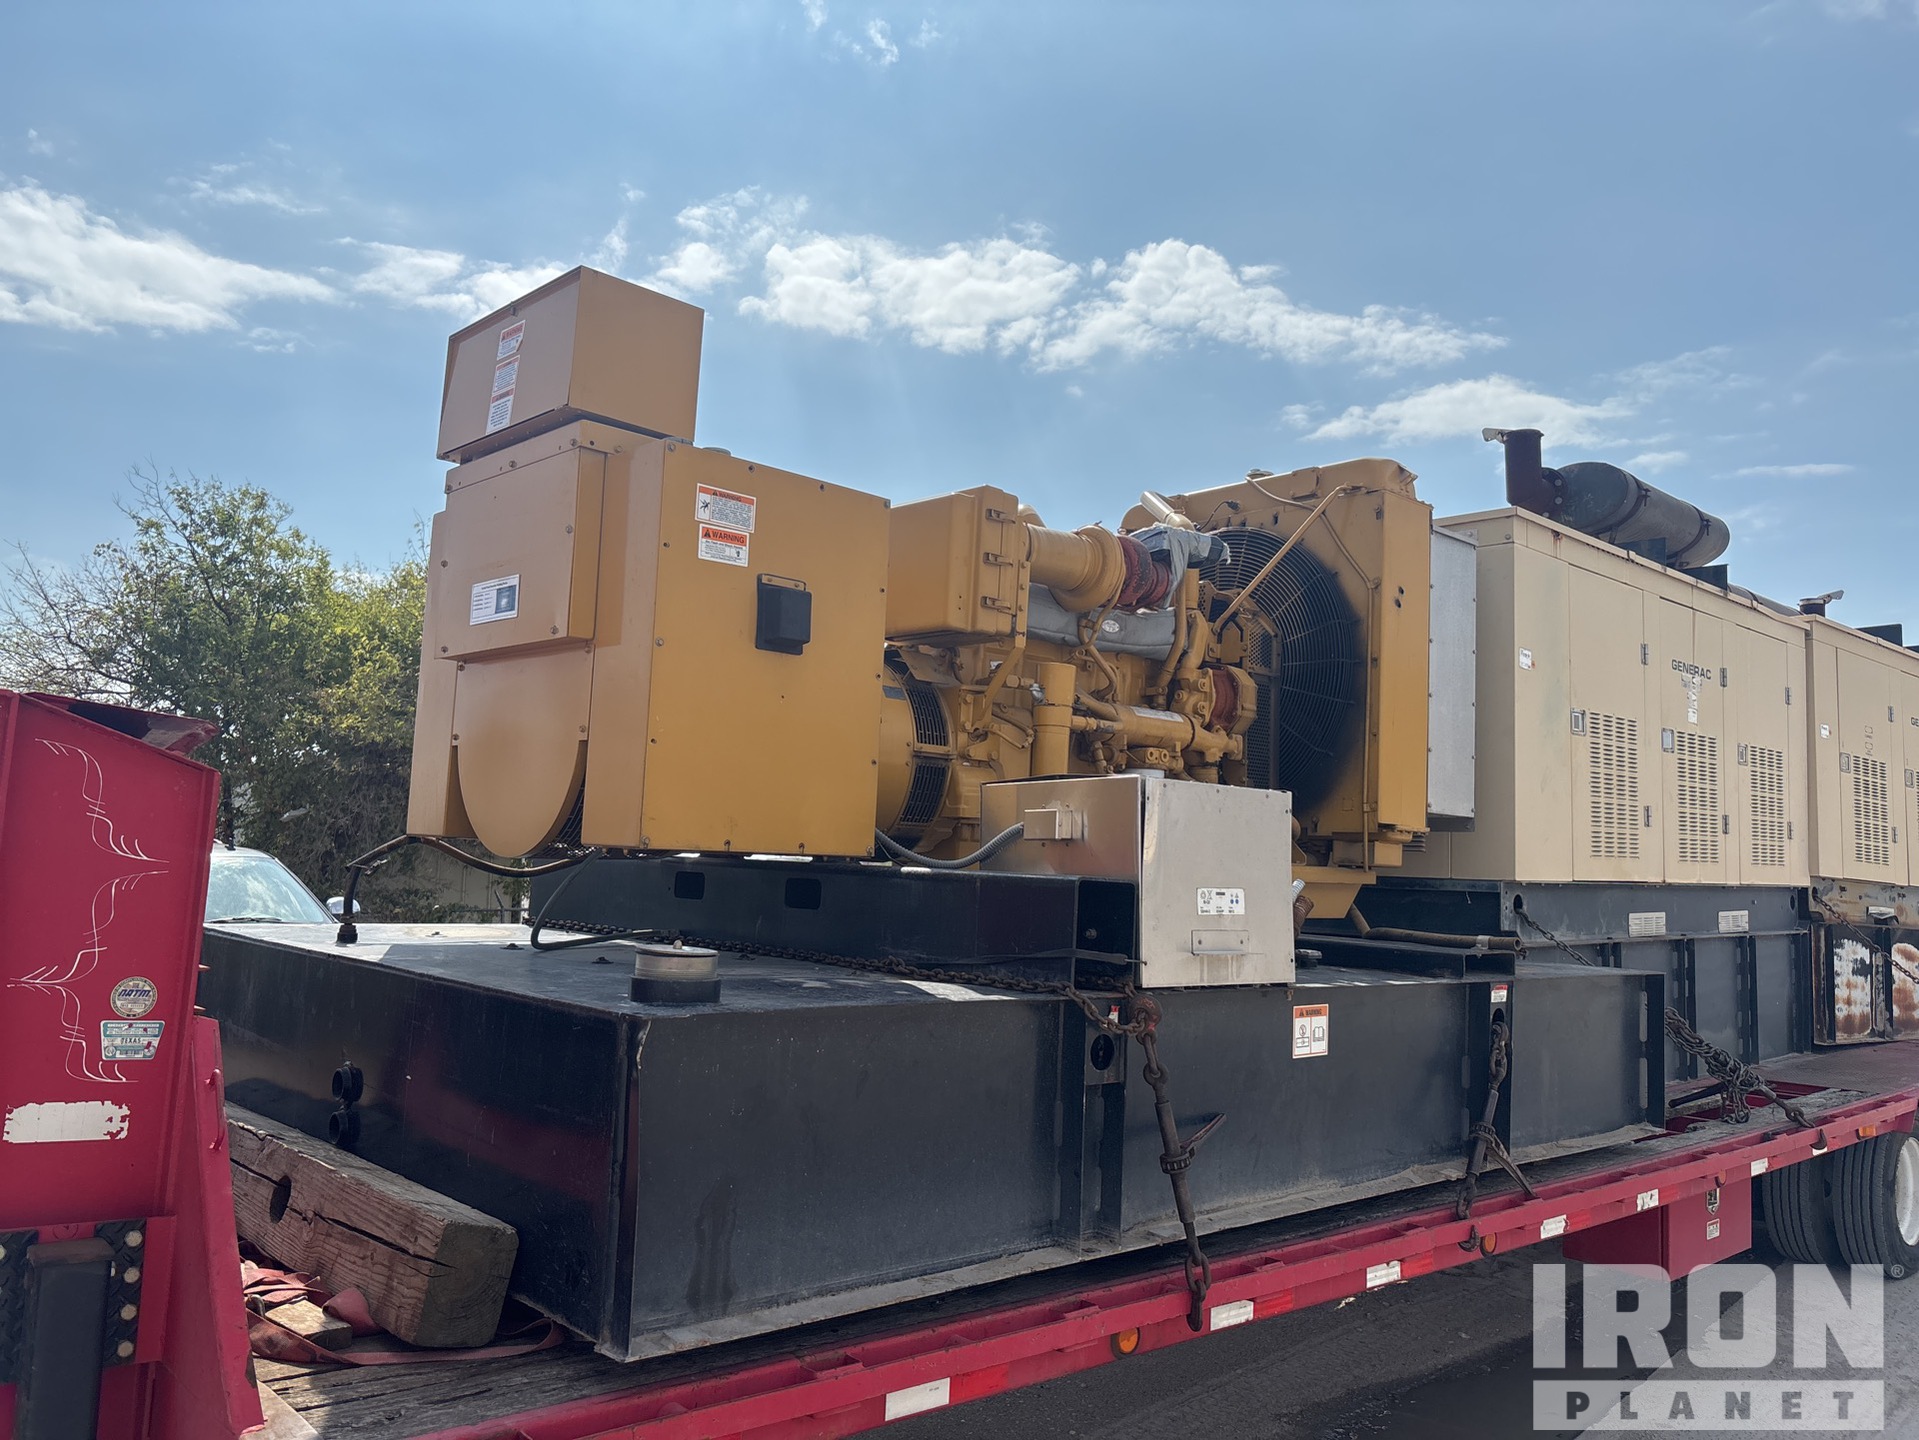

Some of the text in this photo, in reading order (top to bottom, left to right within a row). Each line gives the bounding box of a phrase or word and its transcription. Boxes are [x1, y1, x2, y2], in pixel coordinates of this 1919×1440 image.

[719, 492, 742, 503] WARNING
[711, 530, 745, 544] WARNING
[1671, 659, 1712, 680] GENERAC
[117, 988, 152, 998] NATM
[1305, 1008, 1323, 1016] WARNING
[120, 1037, 142, 1045] TEXAS
